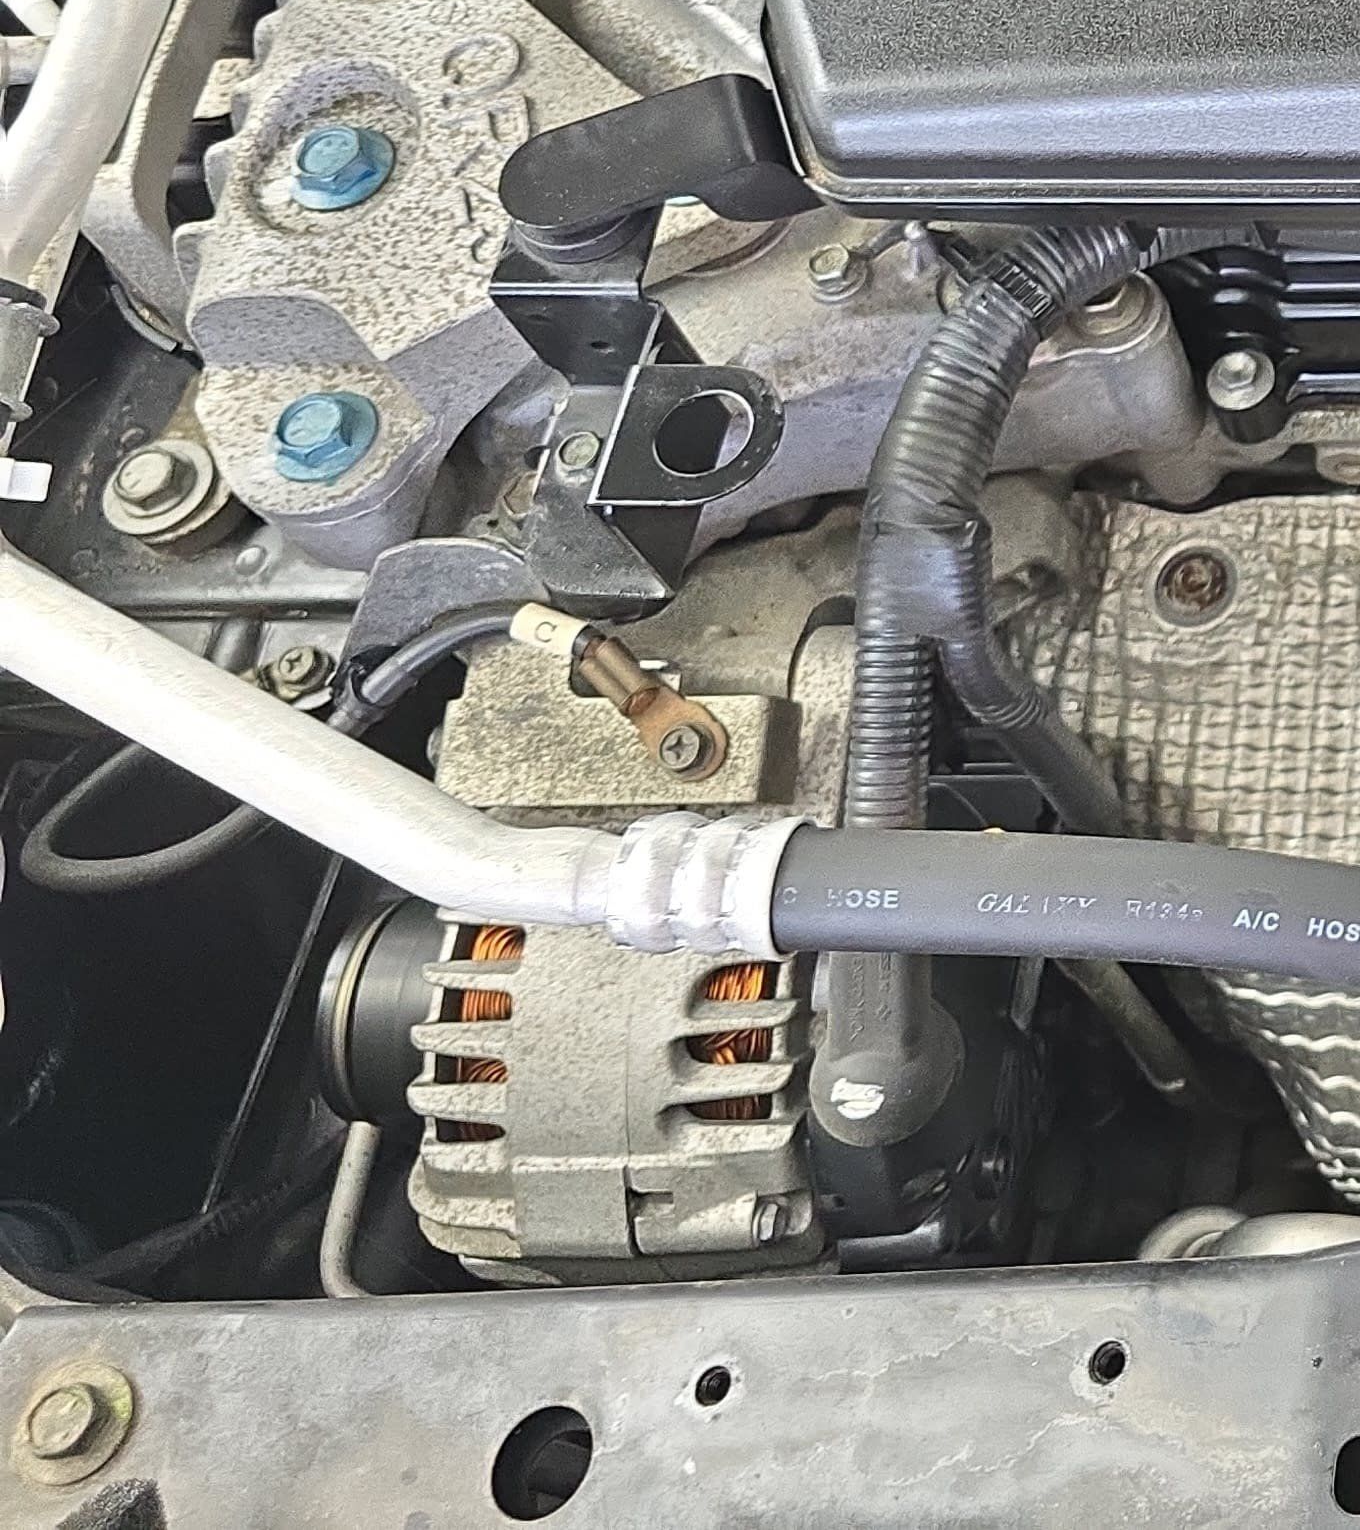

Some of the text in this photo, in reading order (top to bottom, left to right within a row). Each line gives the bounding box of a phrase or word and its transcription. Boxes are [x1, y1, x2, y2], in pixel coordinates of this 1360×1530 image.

[535, 621, 558, 643] C
[825, 887, 900, 910] HOSE
[1232, 907, 1281, 932] A/C
